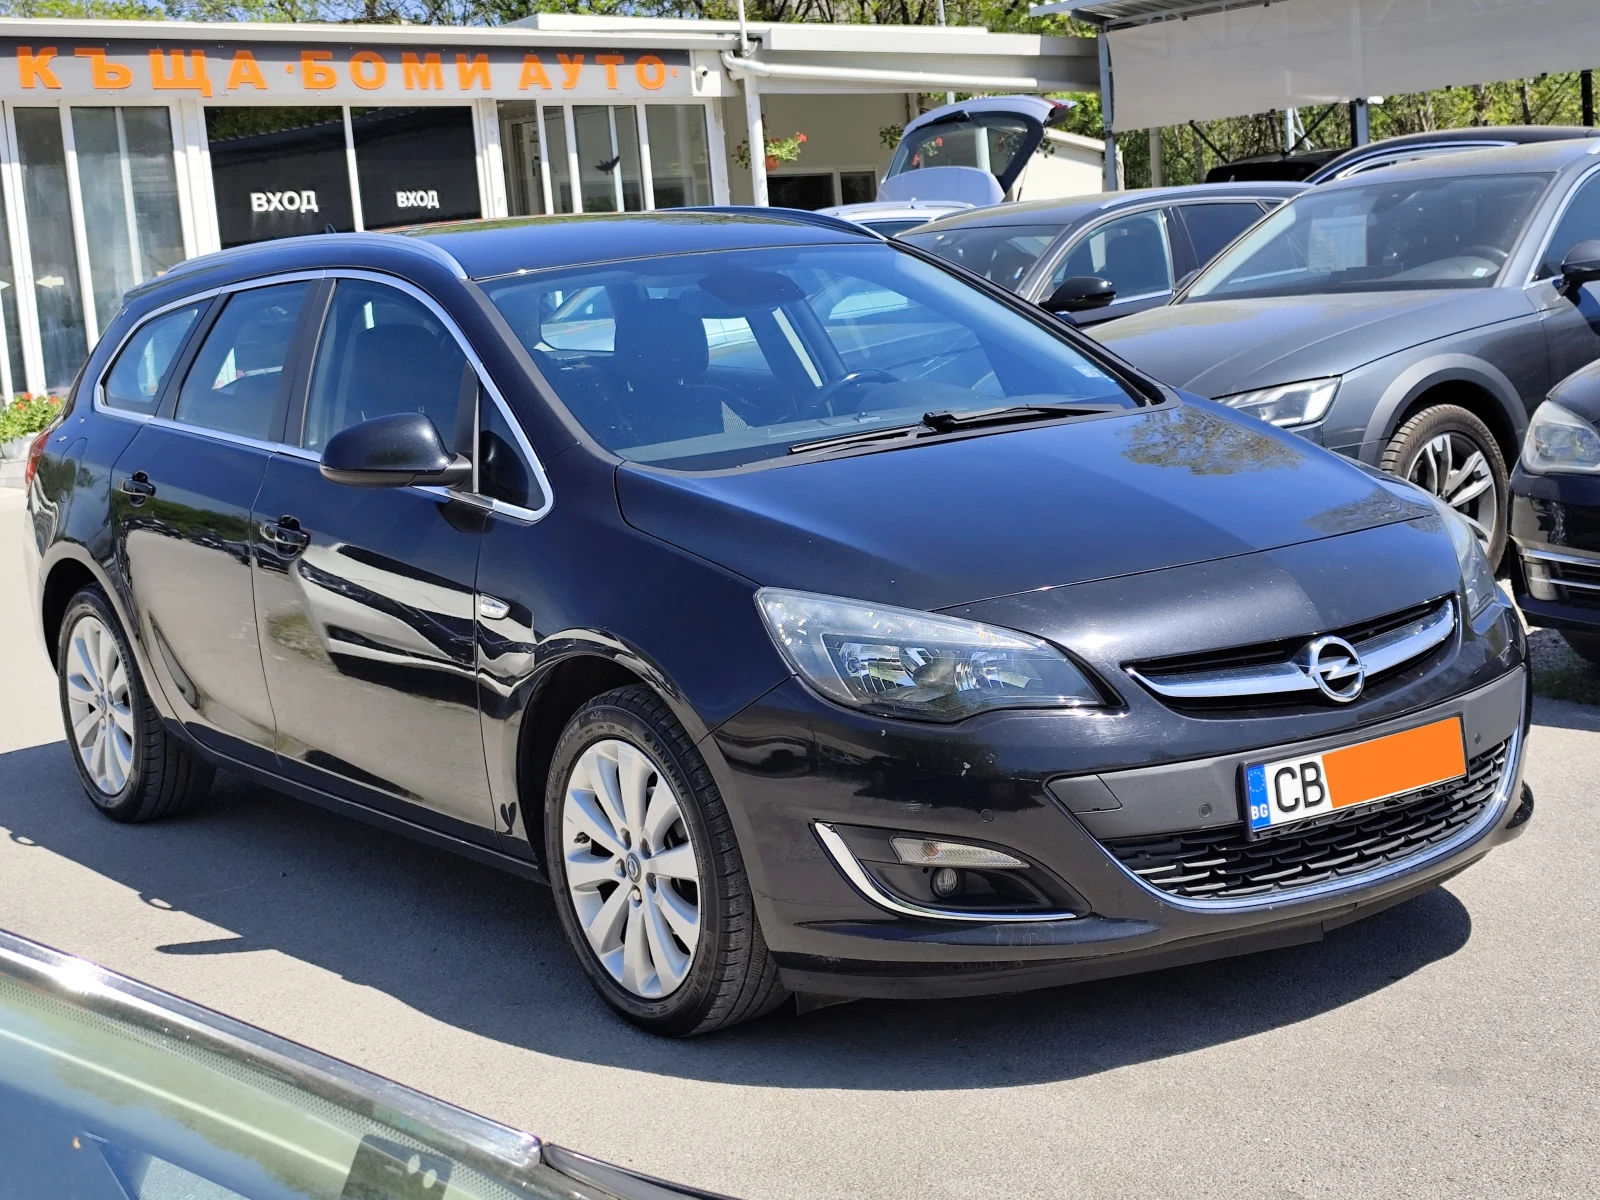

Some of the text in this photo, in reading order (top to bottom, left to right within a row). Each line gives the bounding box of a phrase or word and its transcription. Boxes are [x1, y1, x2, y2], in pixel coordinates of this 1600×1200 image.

[17, 46, 667, 98] КЪЩА БОМИ АУТО
[250, 190, 319, 213] ВХОД
[396, 190, 440, 209] ВХОД
[1251, 803, 1269, 820] BG
